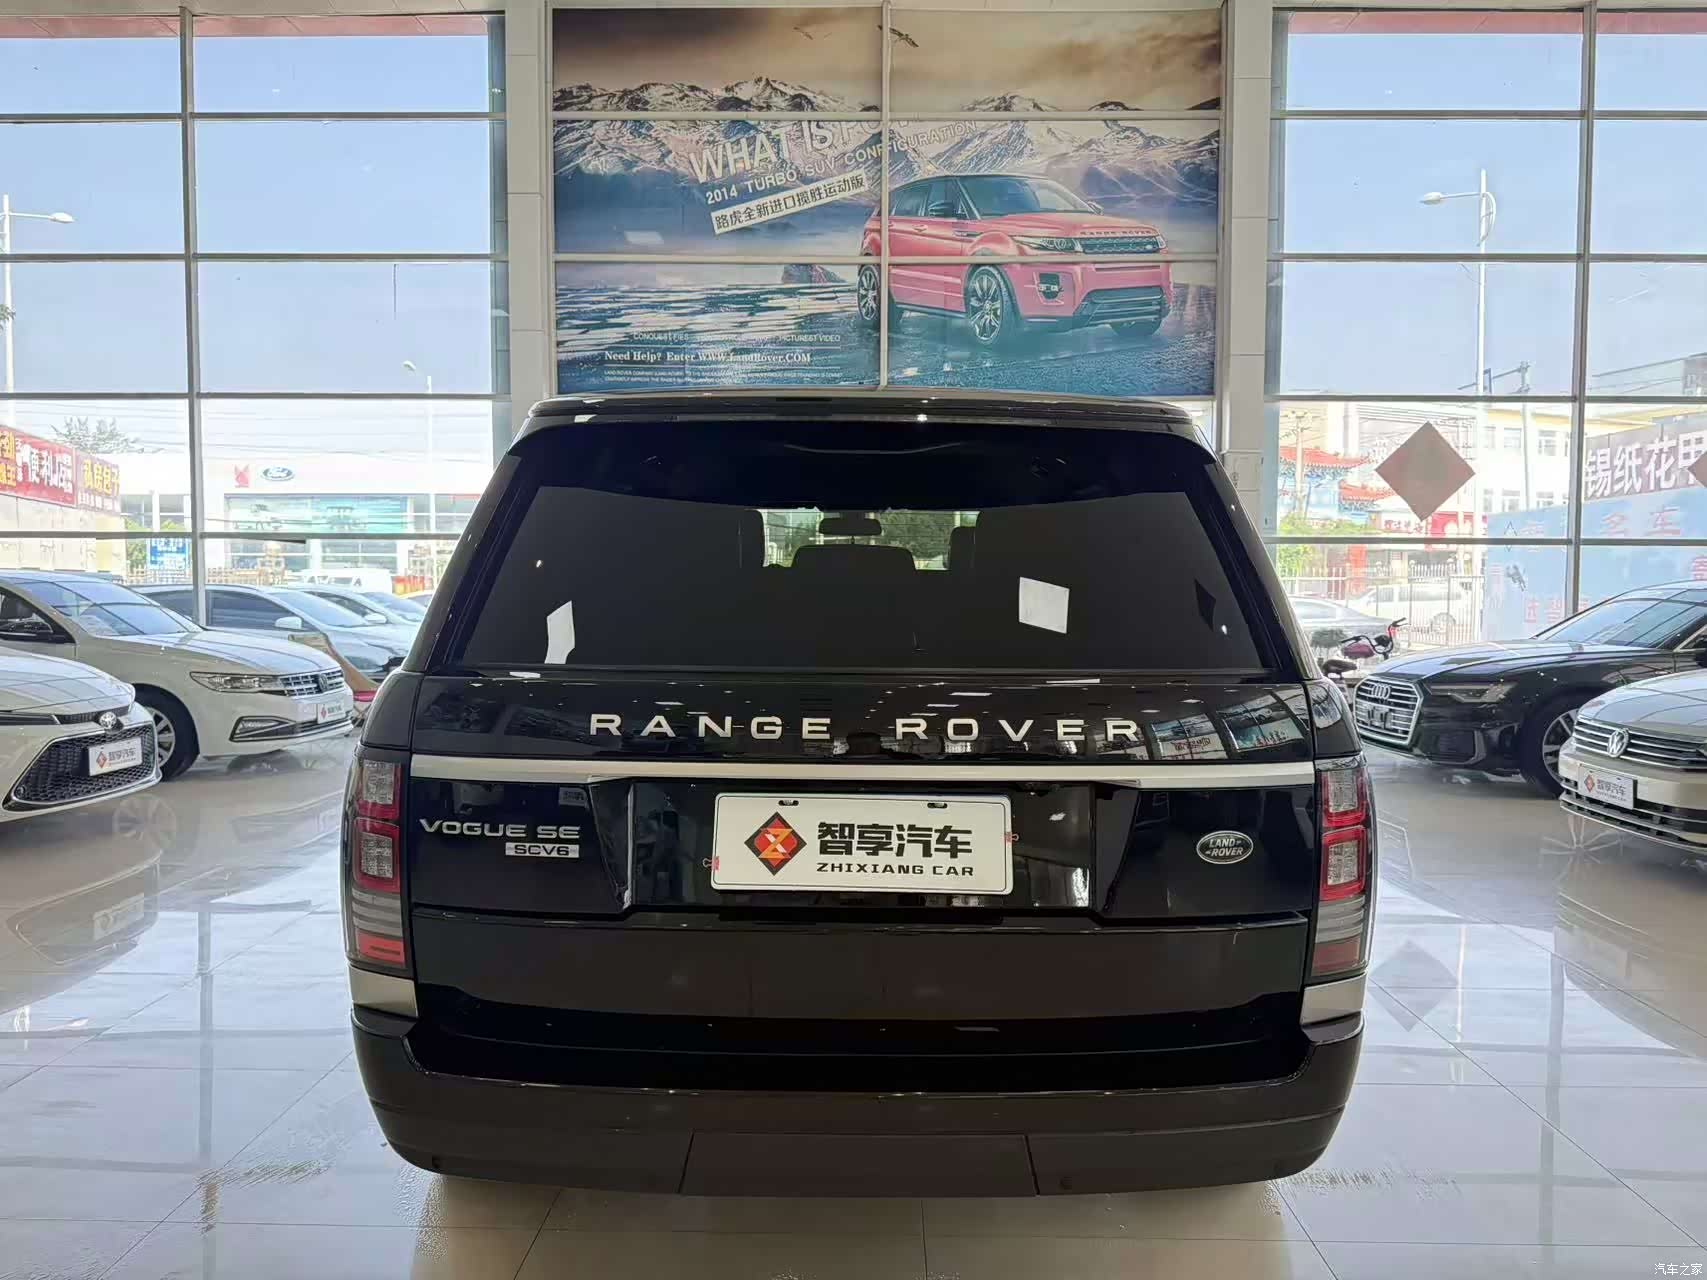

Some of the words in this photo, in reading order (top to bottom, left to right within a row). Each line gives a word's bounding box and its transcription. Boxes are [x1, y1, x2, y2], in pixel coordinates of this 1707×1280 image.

[689, 128, 792, 183] WHAT
[802, 119, 833, 152] IS
[706, 185, 738, 205] 2014
[743, 170, 797, 194] TURBO
[805, 157, 837, 177] SUV
[714, 174, 865, 229] 路虎全新进口揽胜运动版
[604, 351, 630, 361] Need
[633, 351, 662, 363] Help?
[666, 351, 696, 362] Enter
[1584, 430, 1707, 497] 锡纸花甲
[589, 713, 831, 740] RANGE
[894, 718, 1139, 742] ROVER
[419, 818, 528, 837] VOGUE
[537, 825, 581, 839] SE
[817, 821, 973, 859] 智享汽车
[514, 844, 571, 857] SCV6
[1208, 838, 1236, 848] LAND
[1210, 847, 1244, 857] ROVER
[816, 862, 924, 875] ZHIXIANG
[932, 865, 974, 877] CAR
